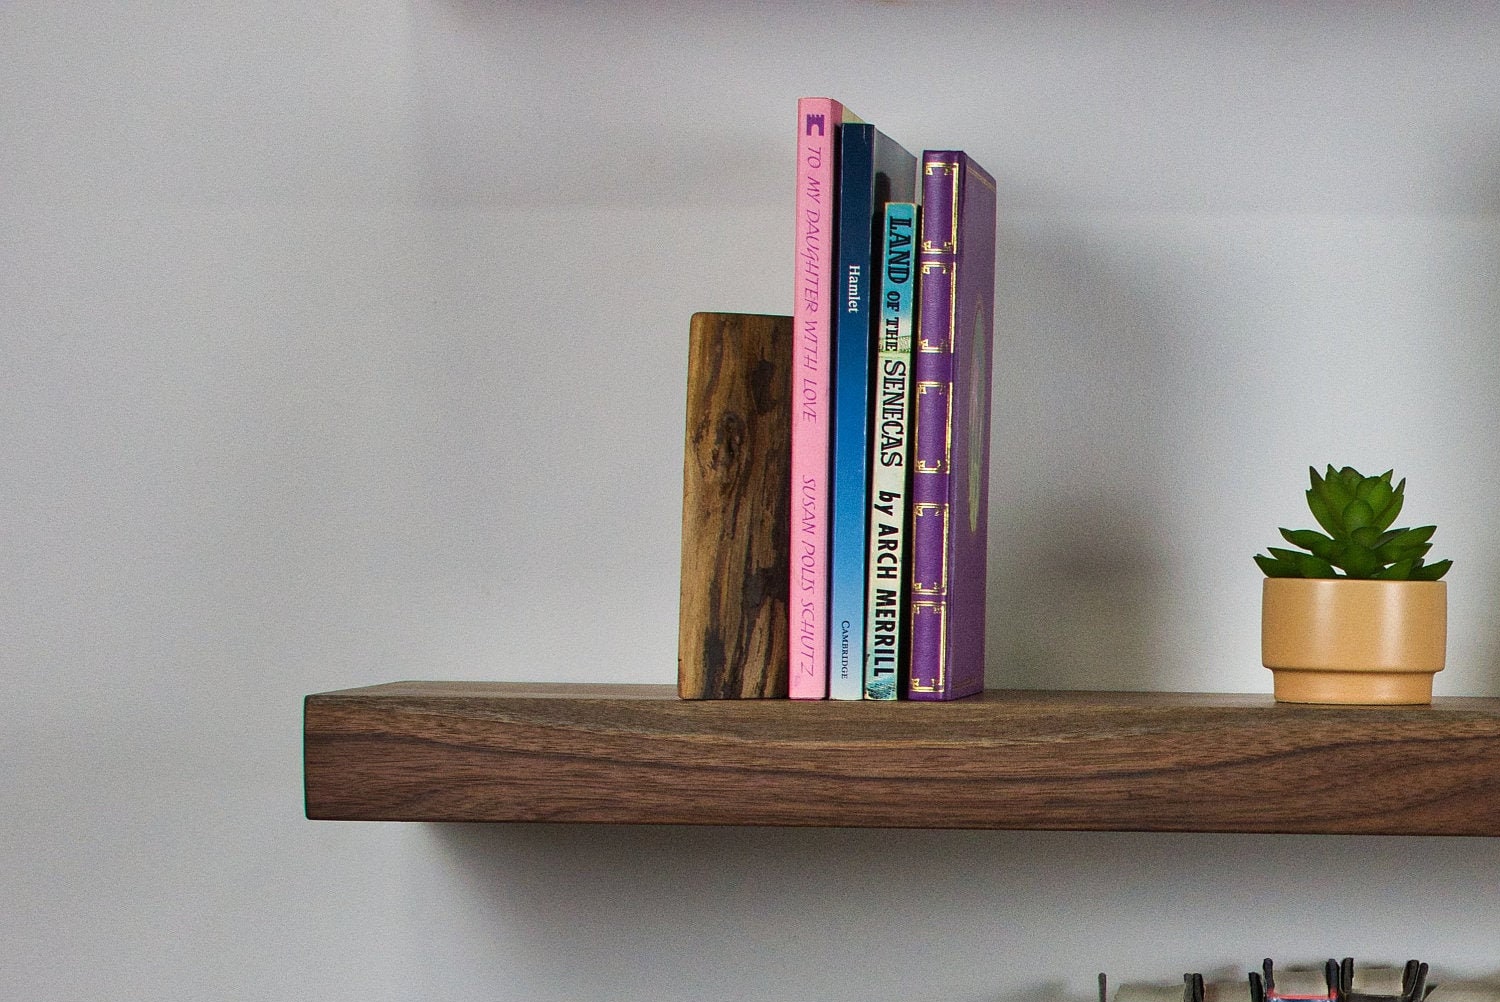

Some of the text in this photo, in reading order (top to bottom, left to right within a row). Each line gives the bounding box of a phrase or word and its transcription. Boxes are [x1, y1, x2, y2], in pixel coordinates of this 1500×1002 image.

[801, 146, 822, 424] TO MY DAUGHTER WITH LOVE
[847, 265, 861, 314] Hamlet
[873, 216, 912, 677] LAND OF THE SENECAS by ARCH MERRILL
[799, 475, 816, 678] SUSAN POLIS SCHUTZ
[841, 620, 851, 679] CAMBRIDGE
